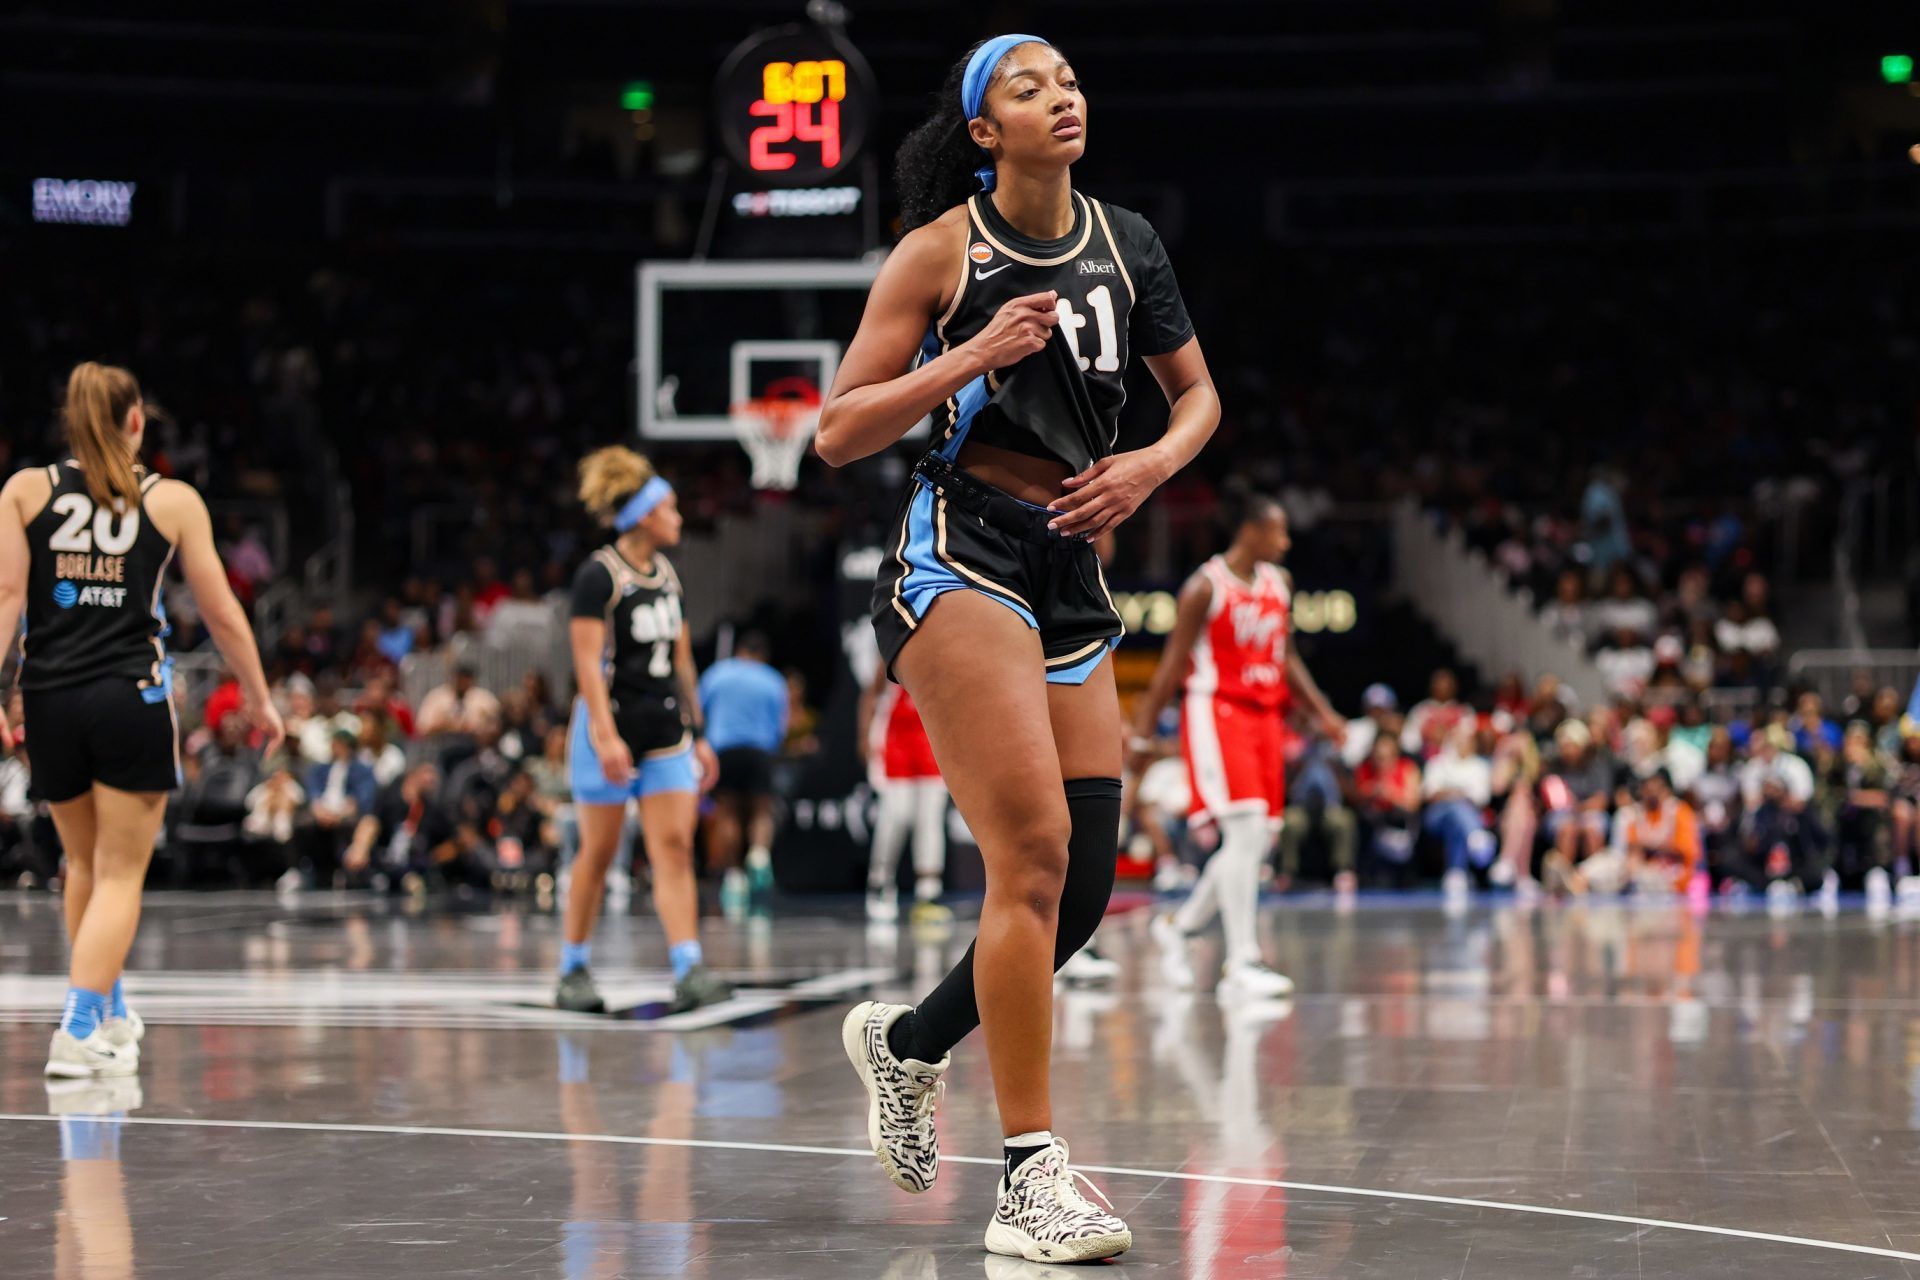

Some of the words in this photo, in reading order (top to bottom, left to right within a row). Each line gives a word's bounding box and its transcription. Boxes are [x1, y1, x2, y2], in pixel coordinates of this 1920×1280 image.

[749, 98, 841, 170] 24
[33, 178, 136, 214] EMORY
[1080, 260, 1116, 274] Albert
[49, 492, 140, 556] 20
[56, 553, 126, 582] BORLASE
[78, 586, 127, 607] AT&T
